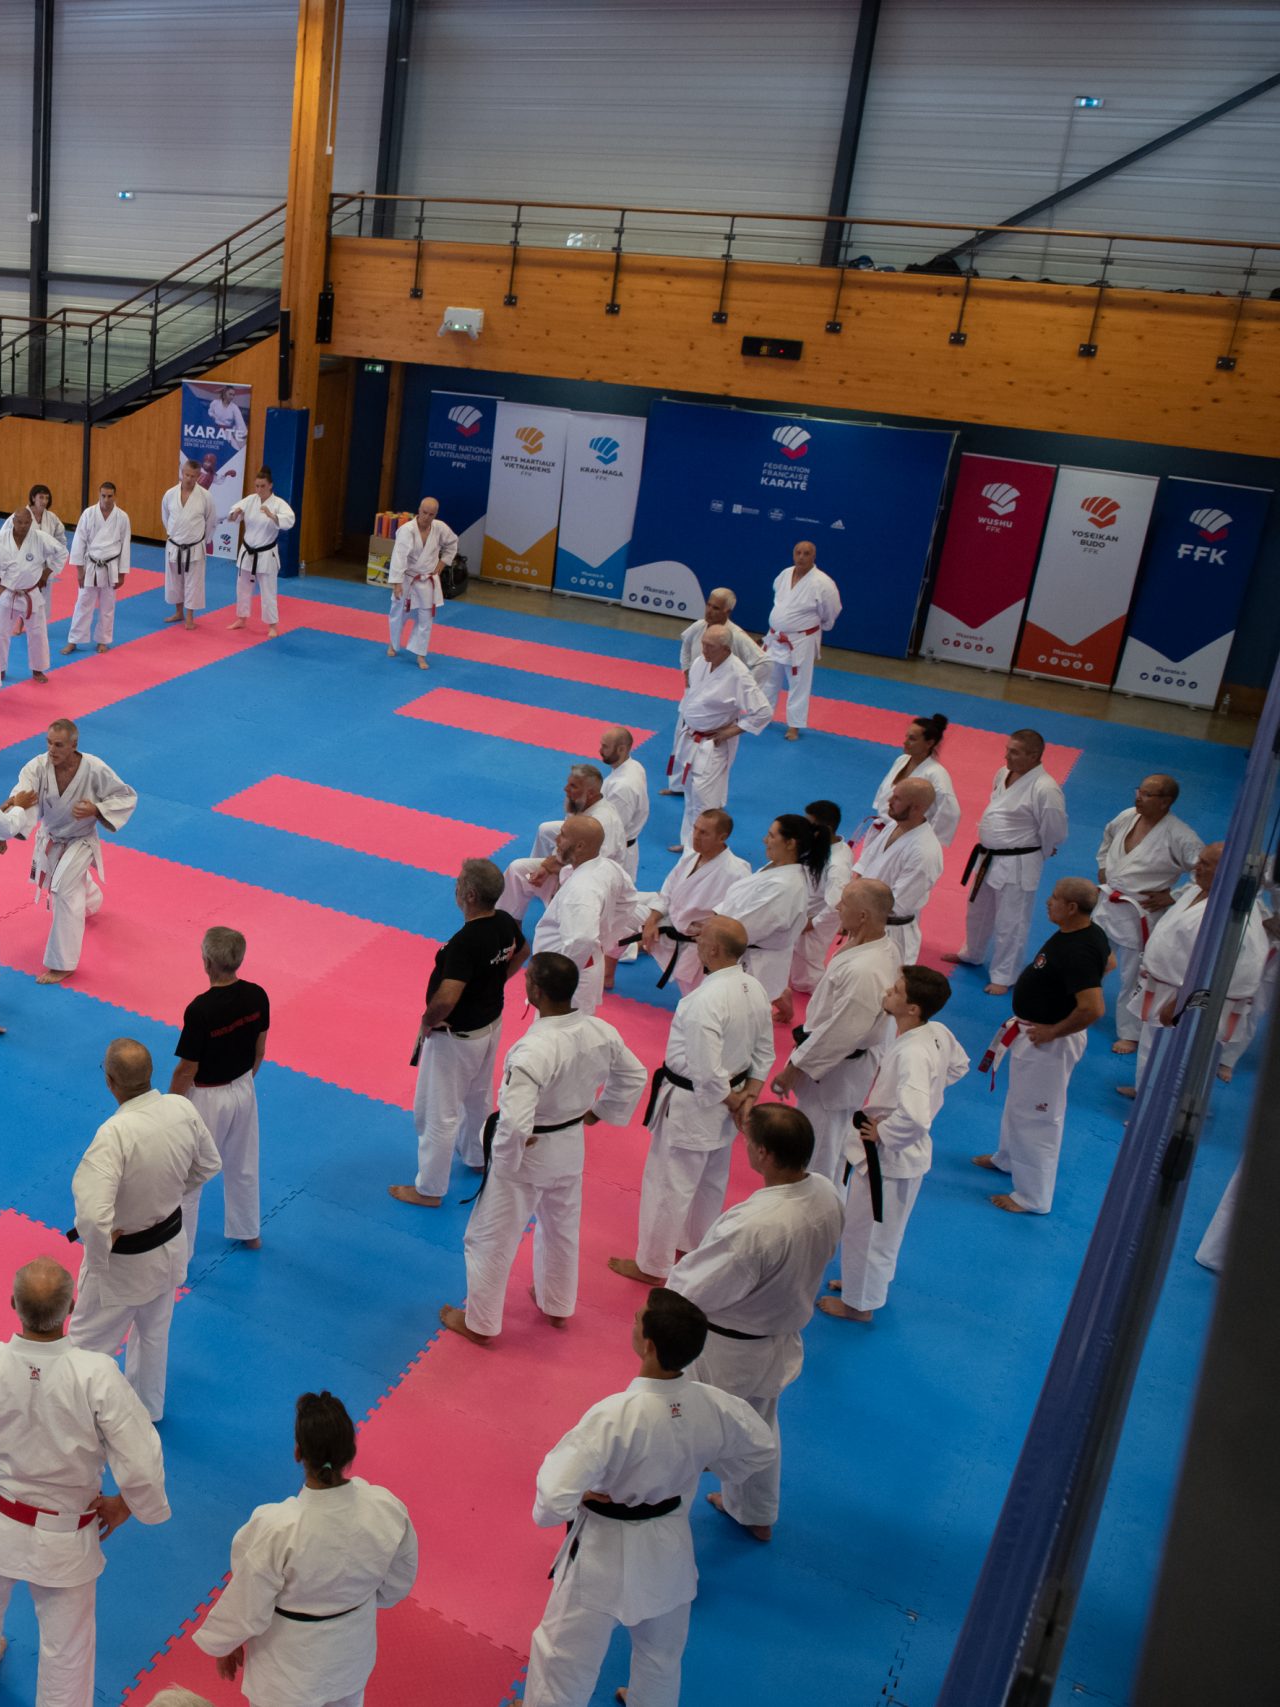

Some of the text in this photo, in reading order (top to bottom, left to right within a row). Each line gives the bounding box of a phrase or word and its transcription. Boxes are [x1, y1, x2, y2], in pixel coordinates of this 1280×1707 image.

[428, 441, 457, 451] CENTRE
[451, 461, 467, 469] FFK
[500, 454, 556, 467] ARTS MARTIAUX
[504, 462, 551, 474] VIETNAMIENS
[579, 467, 624, 478] KRAV-MAGA
[760, 476, 808, 491] KARATÉ
[977, 516, 1013, 528] WUSHU
[985, 525, 1001, 534] FFK
[1071, 529, 1119, 542] YOSEIKAN
[218, 545, 232, 553] FFK
[1080, 539, 1106, 549] BUDO
[1177, 543, 1228, 566] FFK
[643, 585, 676, 597] ffkarate.fr
